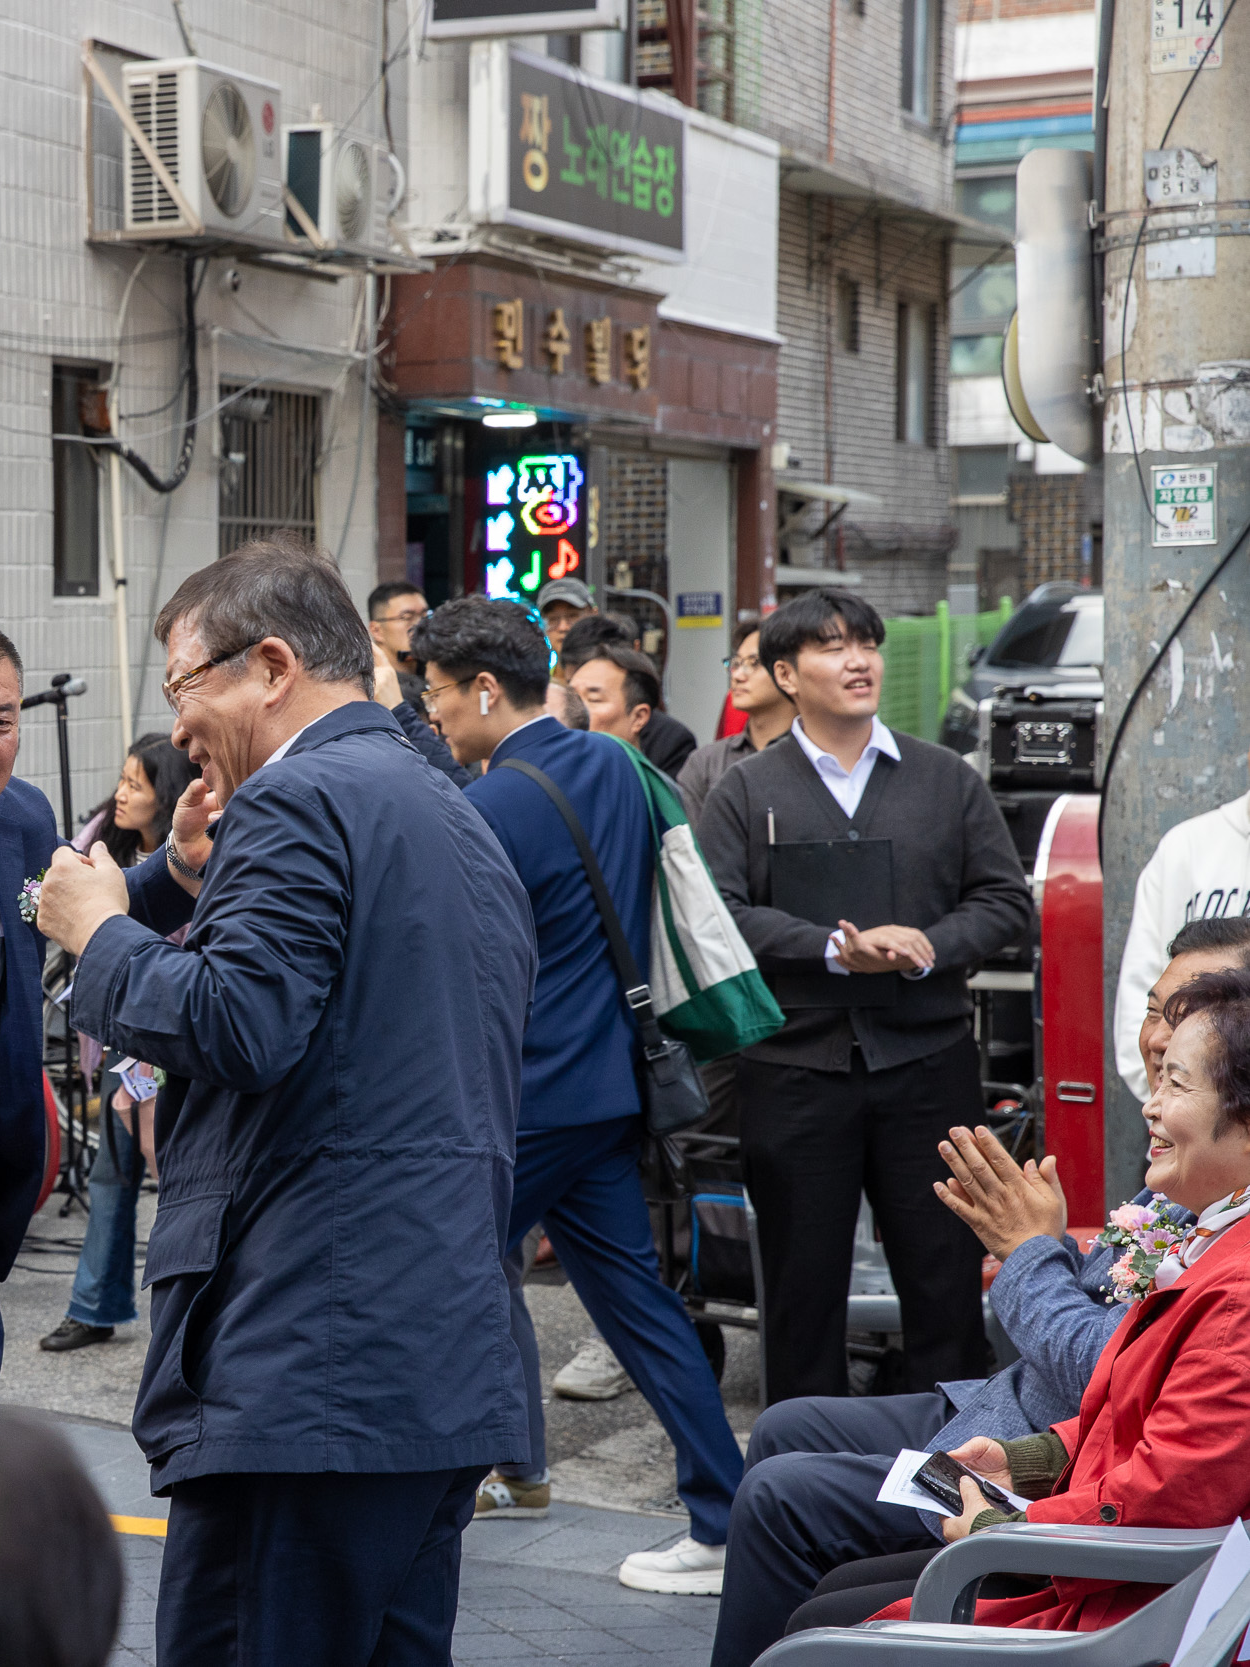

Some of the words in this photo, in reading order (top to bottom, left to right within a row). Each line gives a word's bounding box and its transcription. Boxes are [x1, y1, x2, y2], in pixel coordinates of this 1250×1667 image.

[1173, 0, 1214, 29] 14
[560, 114, 677, 218] 노래연습장
[1159, 487, 1210, 503] 자양4동
